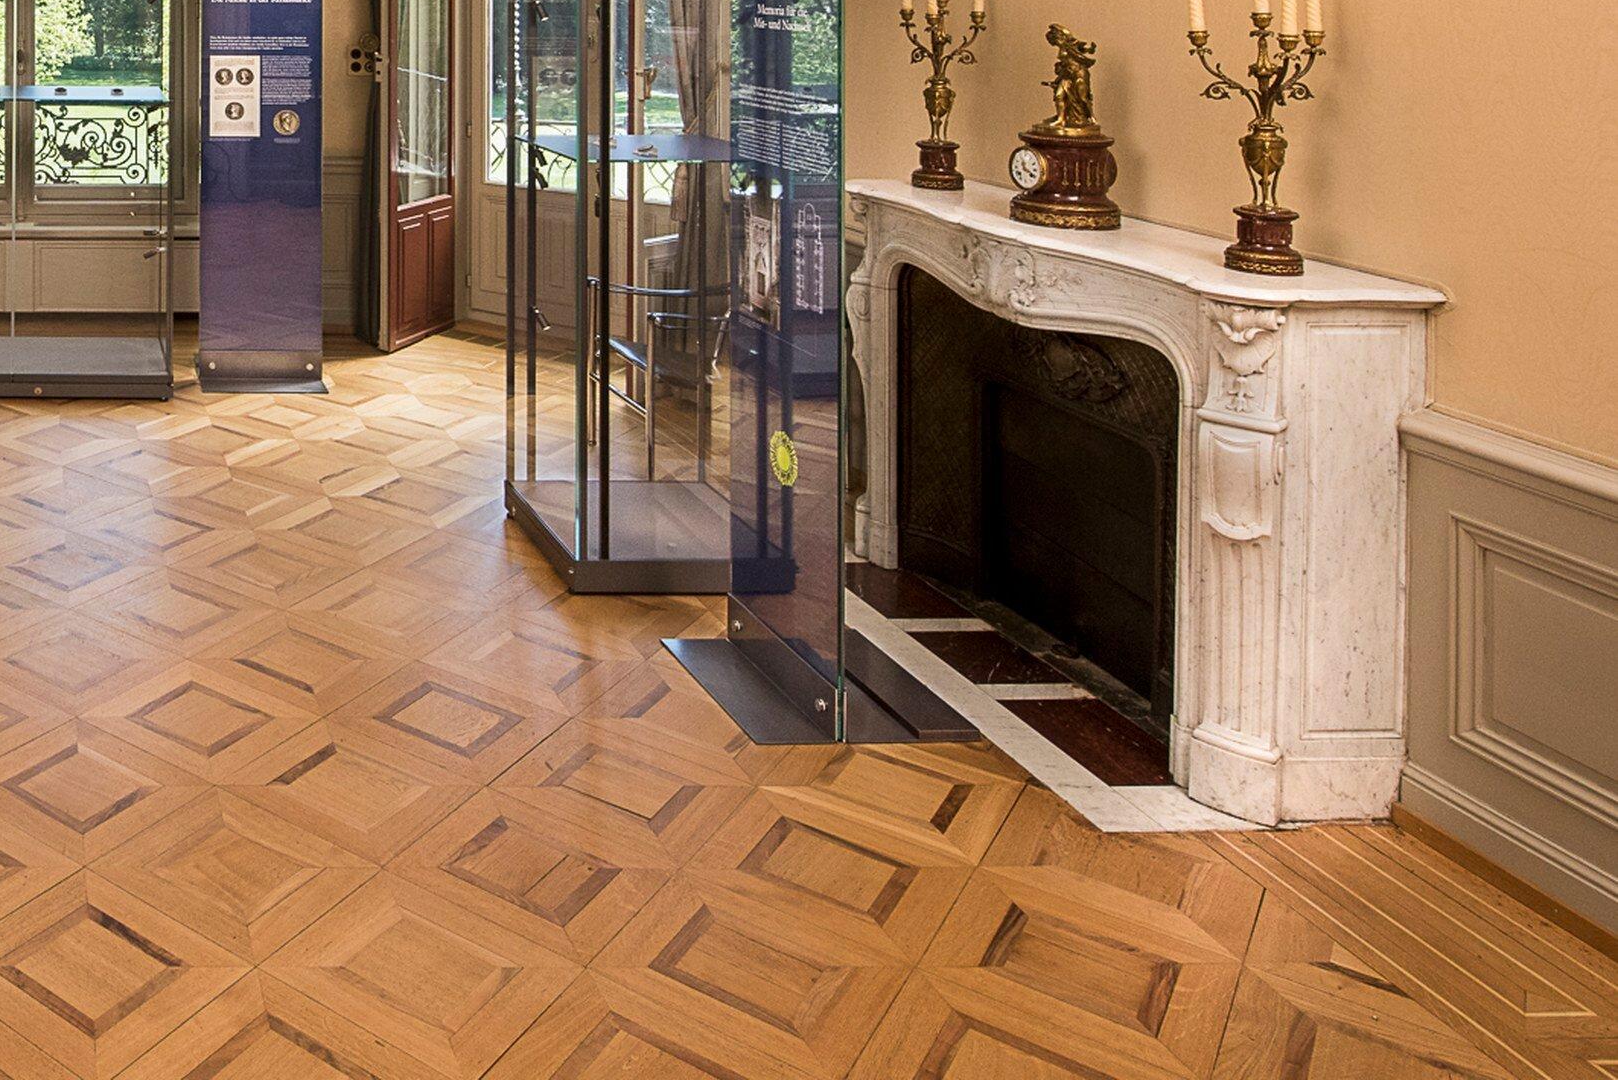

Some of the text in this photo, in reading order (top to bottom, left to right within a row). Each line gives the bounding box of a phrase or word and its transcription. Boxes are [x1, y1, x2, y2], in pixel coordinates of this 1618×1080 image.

[757, 4, 784, 16] Memoria
[786, 5, 797, 16] für
[753, 17, 768, 29] Mit-
[768, 19, 781, 30] und
